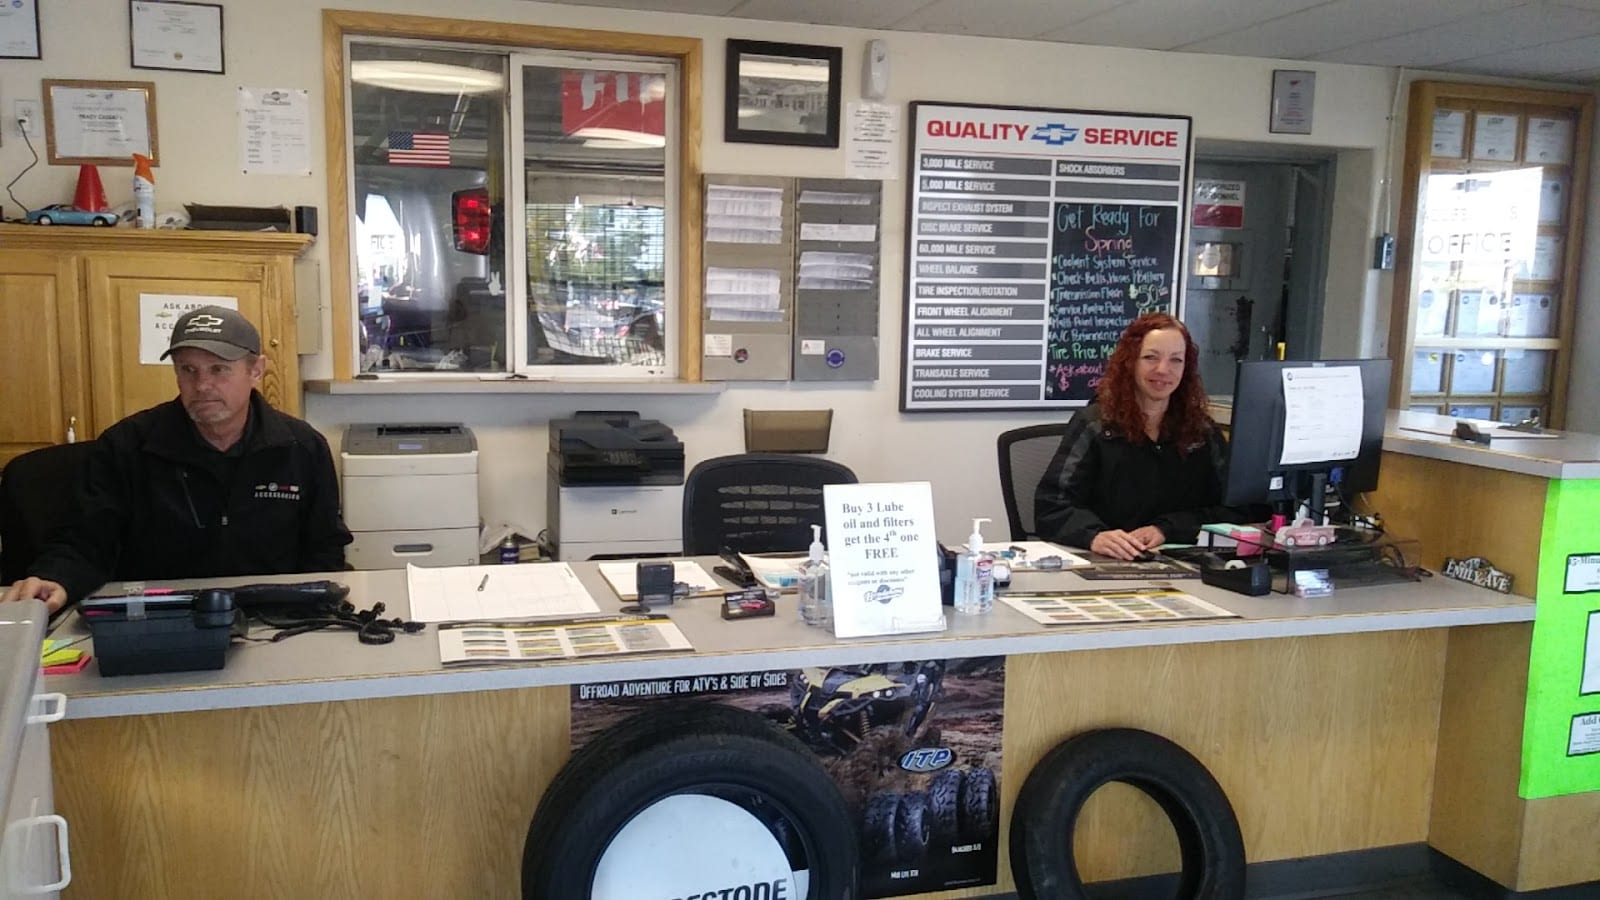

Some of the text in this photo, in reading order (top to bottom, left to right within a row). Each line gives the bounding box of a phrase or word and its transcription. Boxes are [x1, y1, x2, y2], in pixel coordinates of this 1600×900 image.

[927, 120, 1179, 147] QUALITY SERVICE
[944, 159, 963, 169] MILE
[964, 160, 995, 170] SERVICE
[1059, 164, 1126, 175] SHOCK ABSORBERS
[944, 180, 963, 190] MILE
[964, 181, 996, 191] SERVICE
[952, 202, 984, 212] EXHAUST
[985, 203, 1013, 213] SYSTEM
[1057, 204, 1160, 235] Get Ready For
[939, 222, 962, 232] BRAKE
[963, 223, 993, 233] SERVICE
[1085, 225, 1134, 257] Spring
[946, 244, 964, 254] MILE
[965, 245, 996, 255] SERVICE
[918, 264, 979, 275] WHEEL BALANCE
[918, 286, 935, 296] TIRE
[917, 307, 1013, 317] FRONT WHEEL ALIGNMENT
[916, 327, 1002, 337] ALL WHEEL ALIGNMENT
[915, 348, 972, 358] BRAKE SERVICE
[1050, 343, 1069, 360] Tire
[1072, 342, 1099, 360] Price
[915, 368, 990, 378] TRANSAXLE SERVICE
[914, 388, 1010, 398] COOLING SYSTEM SERVICE
[842, 502, 904, 516] Buy 3 Lube
[843, 517, 914, 529] oil and filters
[844, 529, 919, 546] get the 4th one
[865, 548, 898, 559] FREE
[580, 672, 787, 699] OFFROAD ADVENTURE FOR ATV'S & SIDE BY SIDES
[902, 749, 951, 768] ITP
